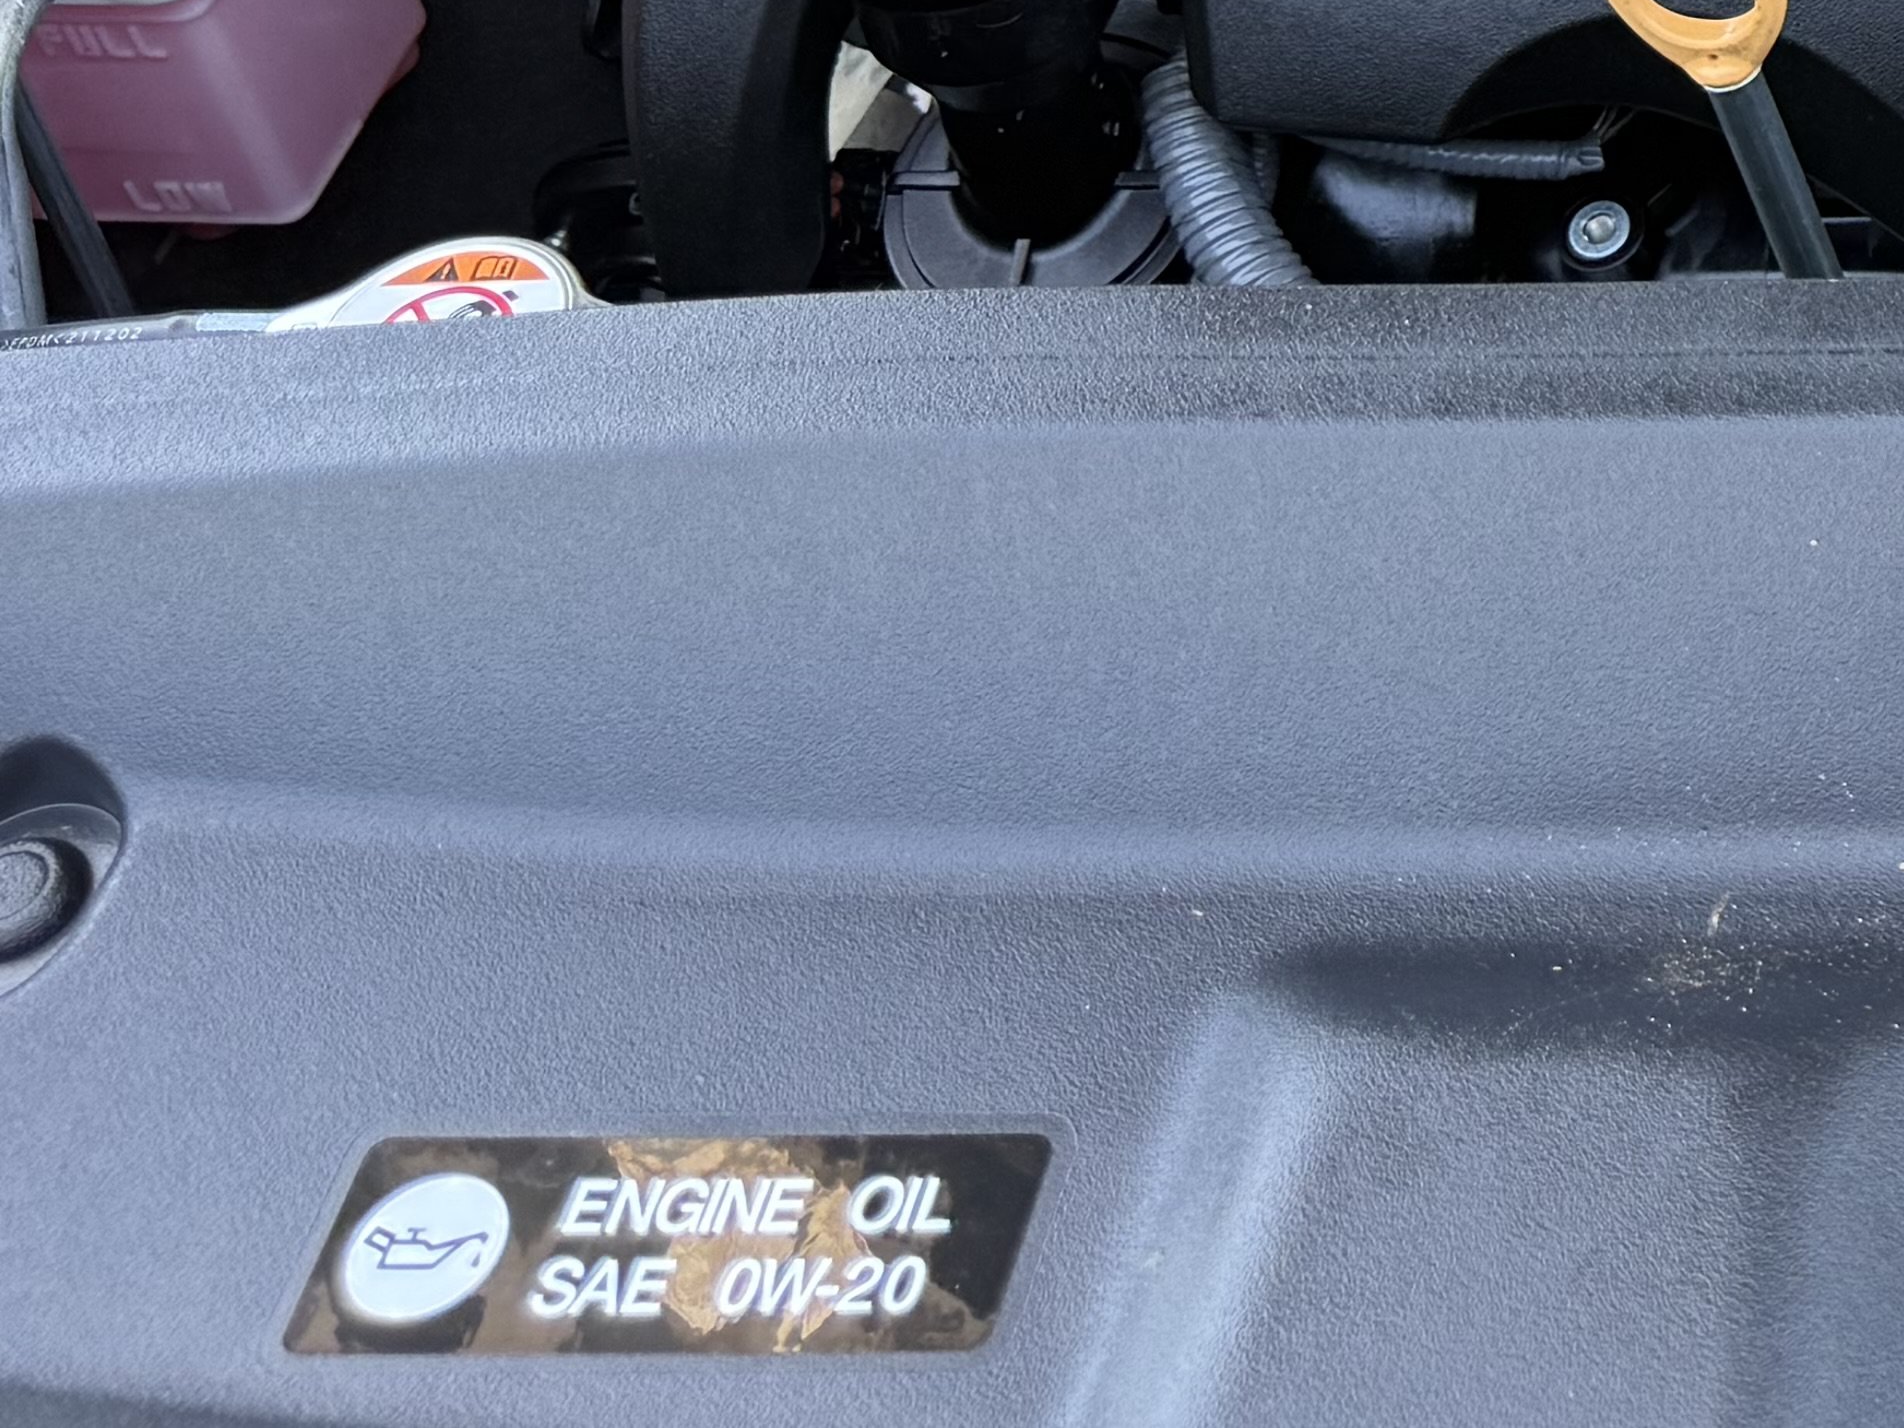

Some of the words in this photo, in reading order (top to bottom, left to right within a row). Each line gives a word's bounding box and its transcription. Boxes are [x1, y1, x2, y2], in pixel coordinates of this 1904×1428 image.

[36, 23, 168, 58] FULL
[122, 179, 233, 213] LOW
[556, 1174, 816, 1237] ENGINE
[847, 1174, 953, 1236] OIL
[527, 1254, 681, 1319] SAE
[714, 1254, 930, 1317] 0W-20
